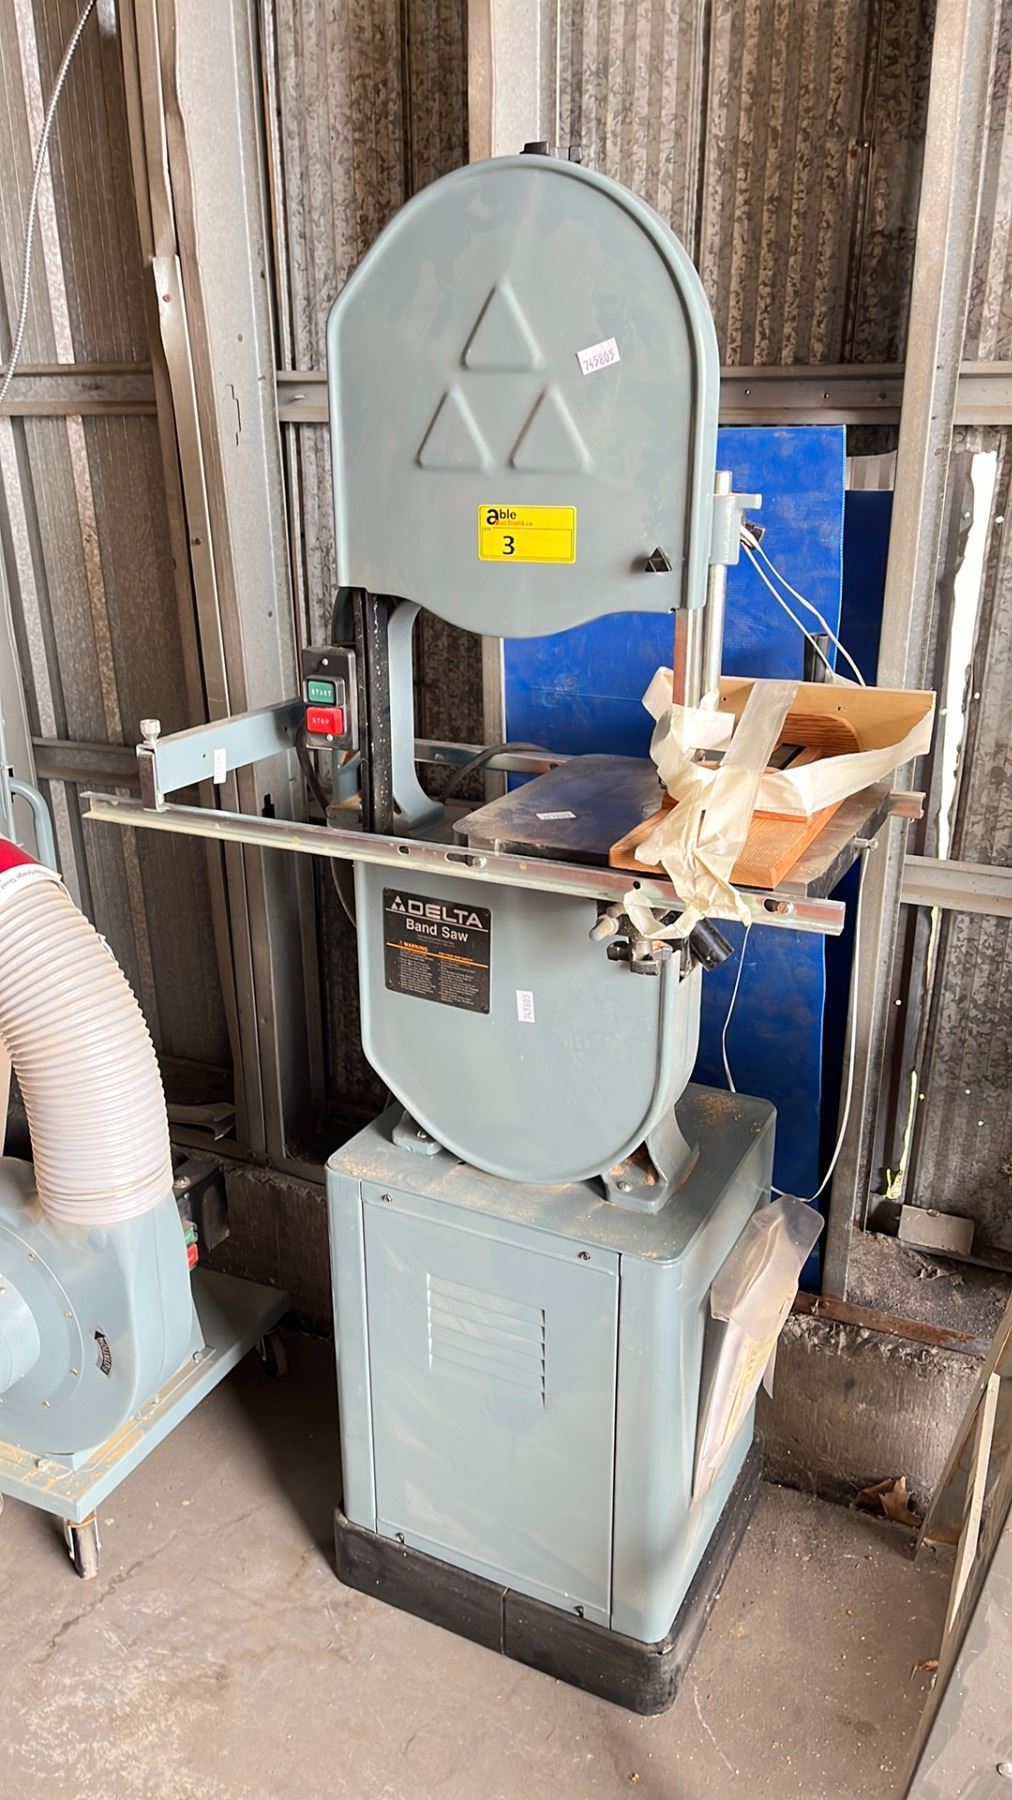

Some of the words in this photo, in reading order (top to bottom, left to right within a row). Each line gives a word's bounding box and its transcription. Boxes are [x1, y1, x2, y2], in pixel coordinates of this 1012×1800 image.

[583, 348, 615, 371] 745805
[486, 508, 517, 526] able
[502, 535, 516, 555] 3
[311, 688, 331, 697] START
[312, 717, 329, 725] STOP
[407, 899, 483, 929] DELTA
[405, 918, 438, 936] Band
[441, 926, 469, 943] Saw
